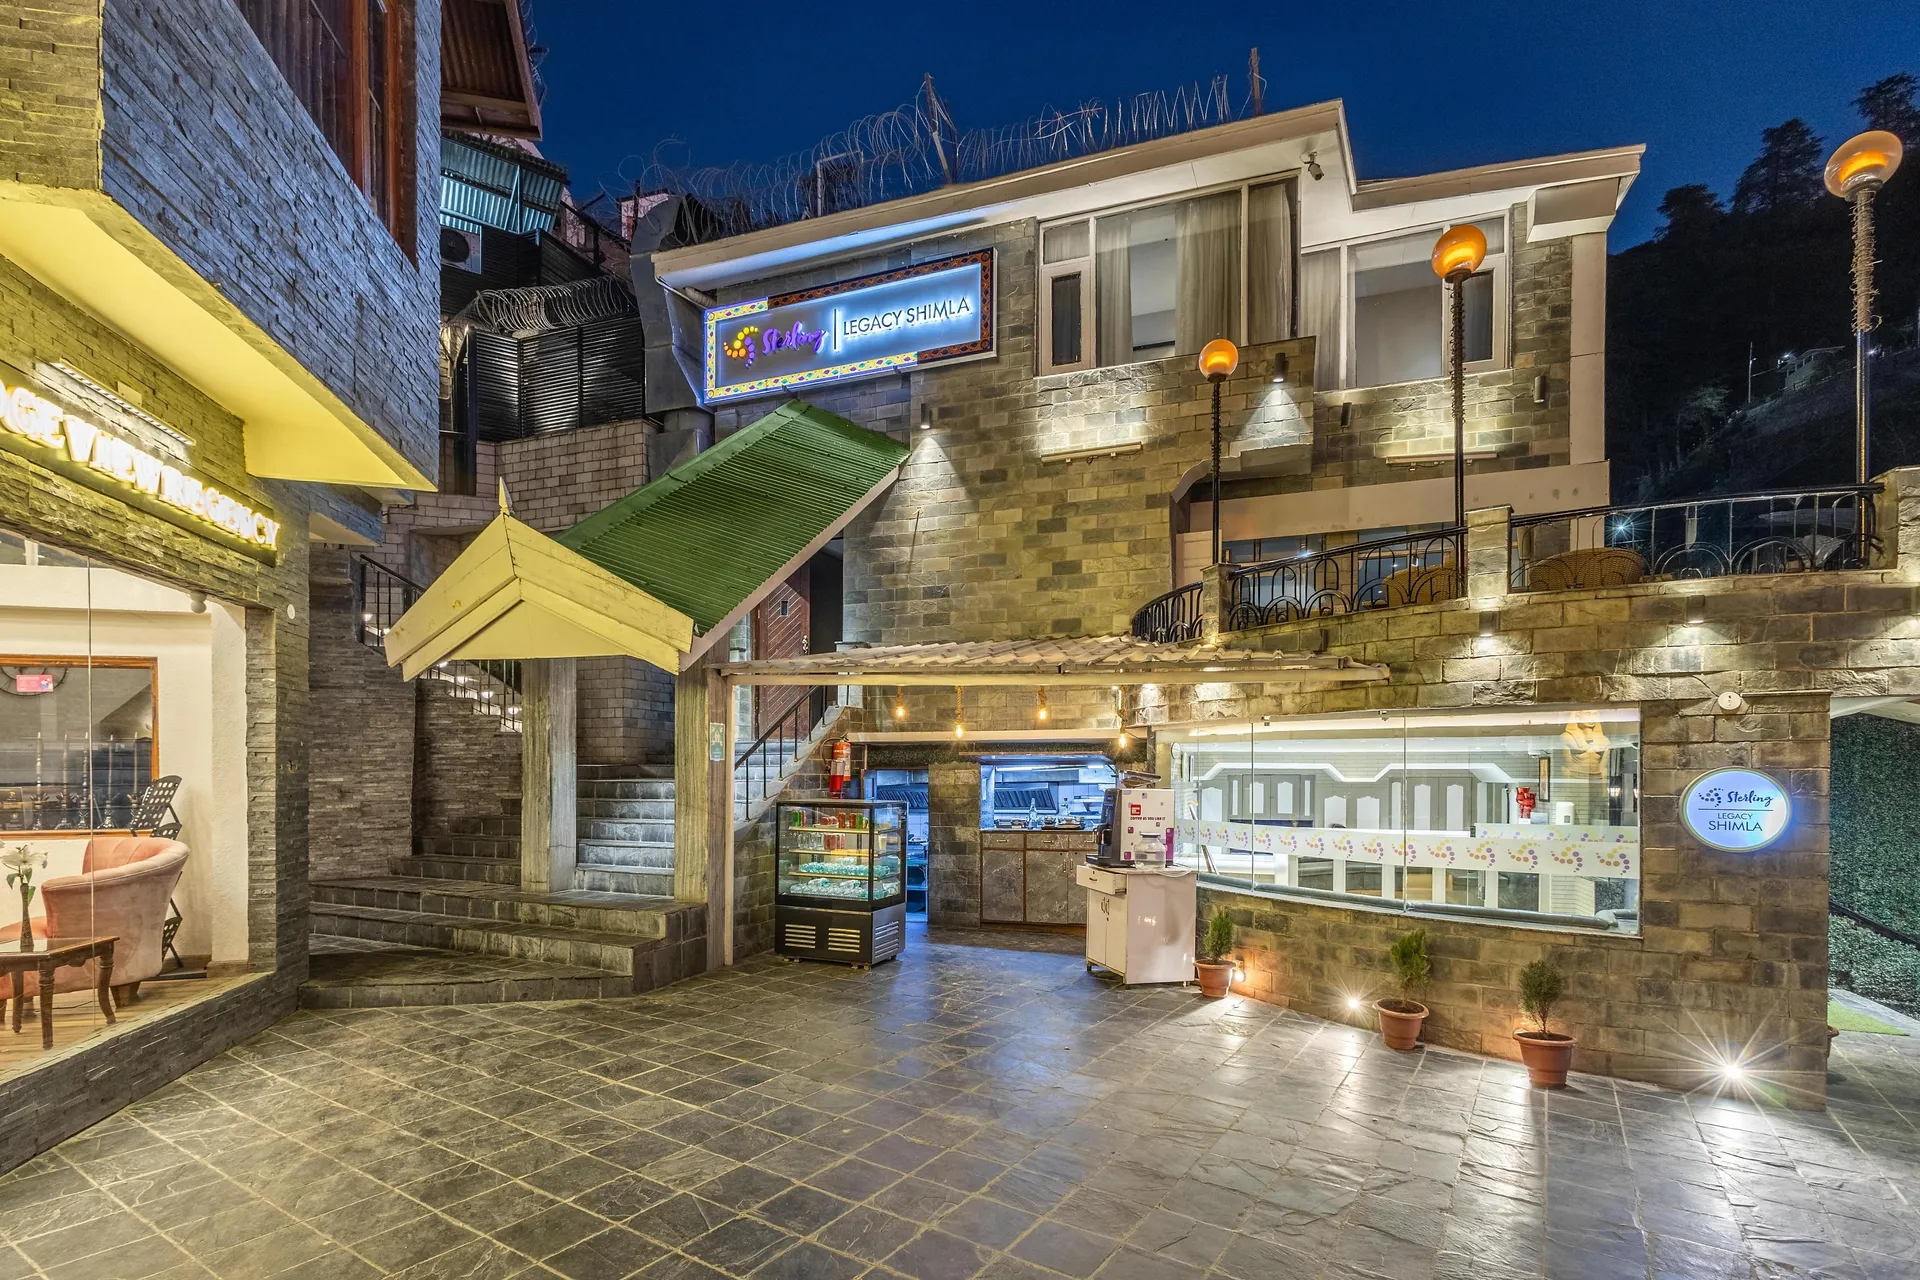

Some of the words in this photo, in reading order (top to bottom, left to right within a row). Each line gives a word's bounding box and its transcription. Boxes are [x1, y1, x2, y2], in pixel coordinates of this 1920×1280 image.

[762, 320, 829, 355] Sterling
[843, 308, 903, 336] LEGACY
[906, 296, 970, 324] SHIMLA
[63, 414, 164, 496] VIEW
[1727, 790, 1774, 808] Sterling
[1717, 812, 1754, 820] LEGACY
[1708, 820, 1763, 832] SHIMLA
